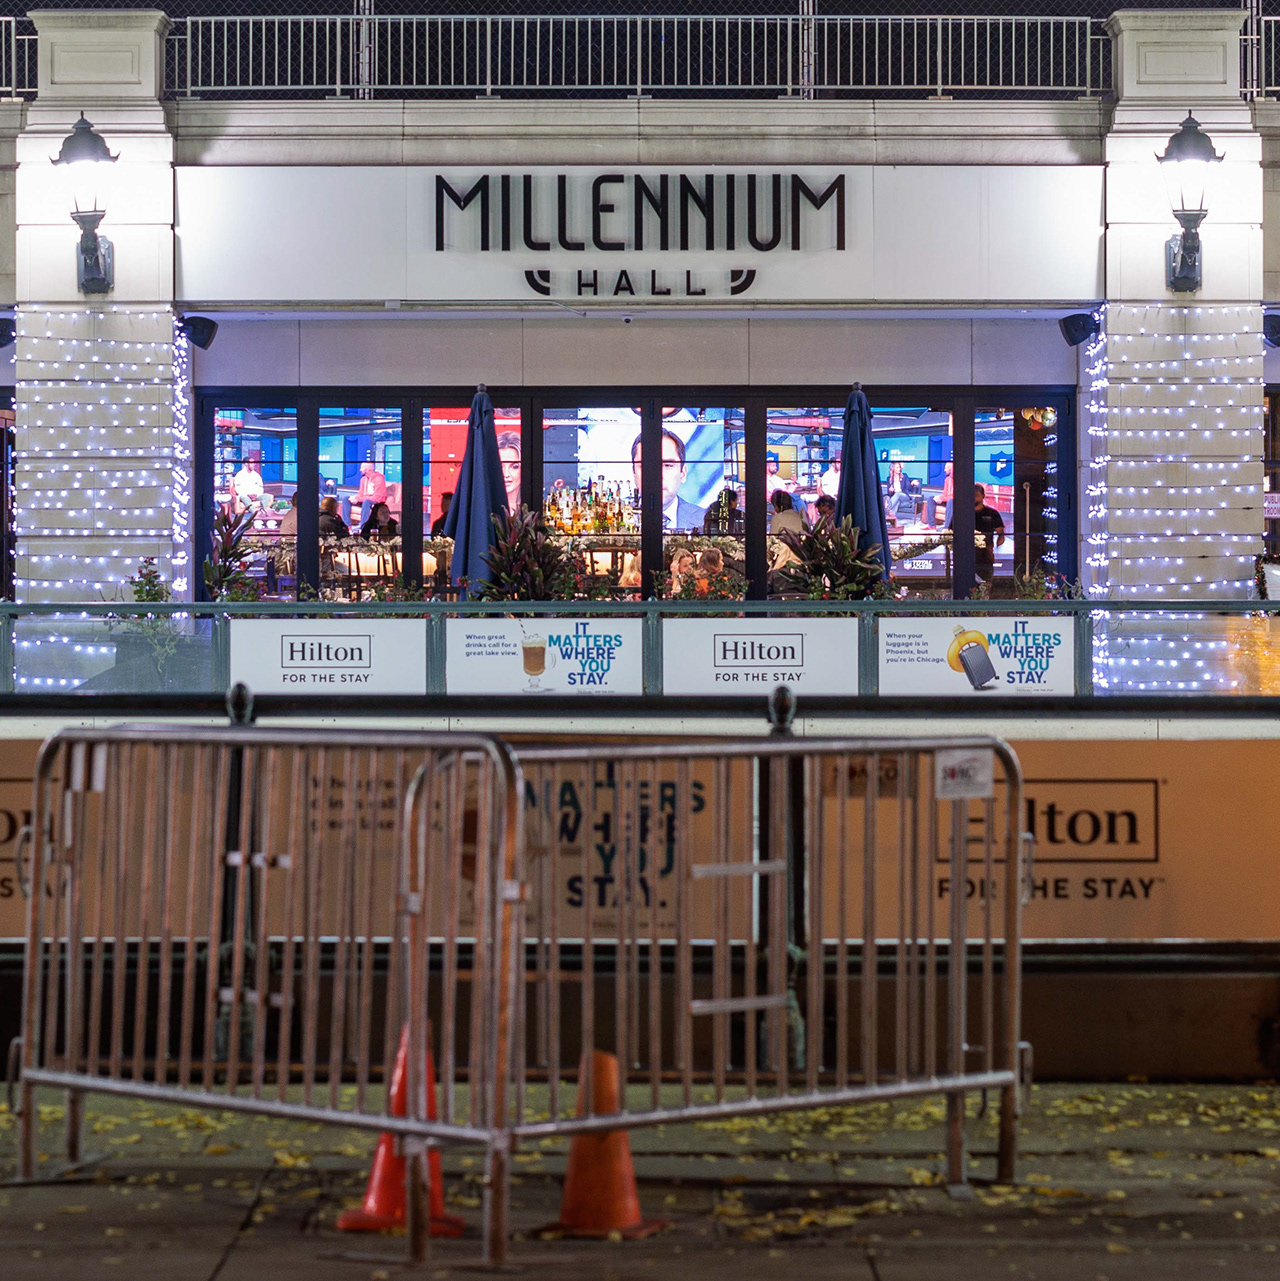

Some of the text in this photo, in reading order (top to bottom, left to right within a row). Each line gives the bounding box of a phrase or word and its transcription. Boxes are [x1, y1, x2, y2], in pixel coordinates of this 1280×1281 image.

[435, 173, 846, 252] MILLENNIUM
[576, 269, 707, 296] HALL
[575, 622, 590, 634] IT
[1014, 621, 1029, 633] IT
[548, 634, 623, 647] MATTERS
[987, 633, 1062, 646] MATTERS
[288, 642, 363, 661] Hilton
[559, 647, 616, 660] WHERE
[721, 641, 796, 660] Hilton
[998, 645, 1055, 658] WHERE
[579, 659, 611, 672] YOU
[886, 656, 907, 664] you're
[1018, 658, 1050, 671] YOU
[282, 673, 370, 683] FOR THE STAY
[567, 672, 608, 685] STAY.
[715, 672, 802, 682] FOR THE STAY
[1006, 671, 1047, 684] STAY.
[950, 797, 1139, 845] lton
[1022, 877, 1068, 899] HE
[1083, 877, 1155, 899] STAY
